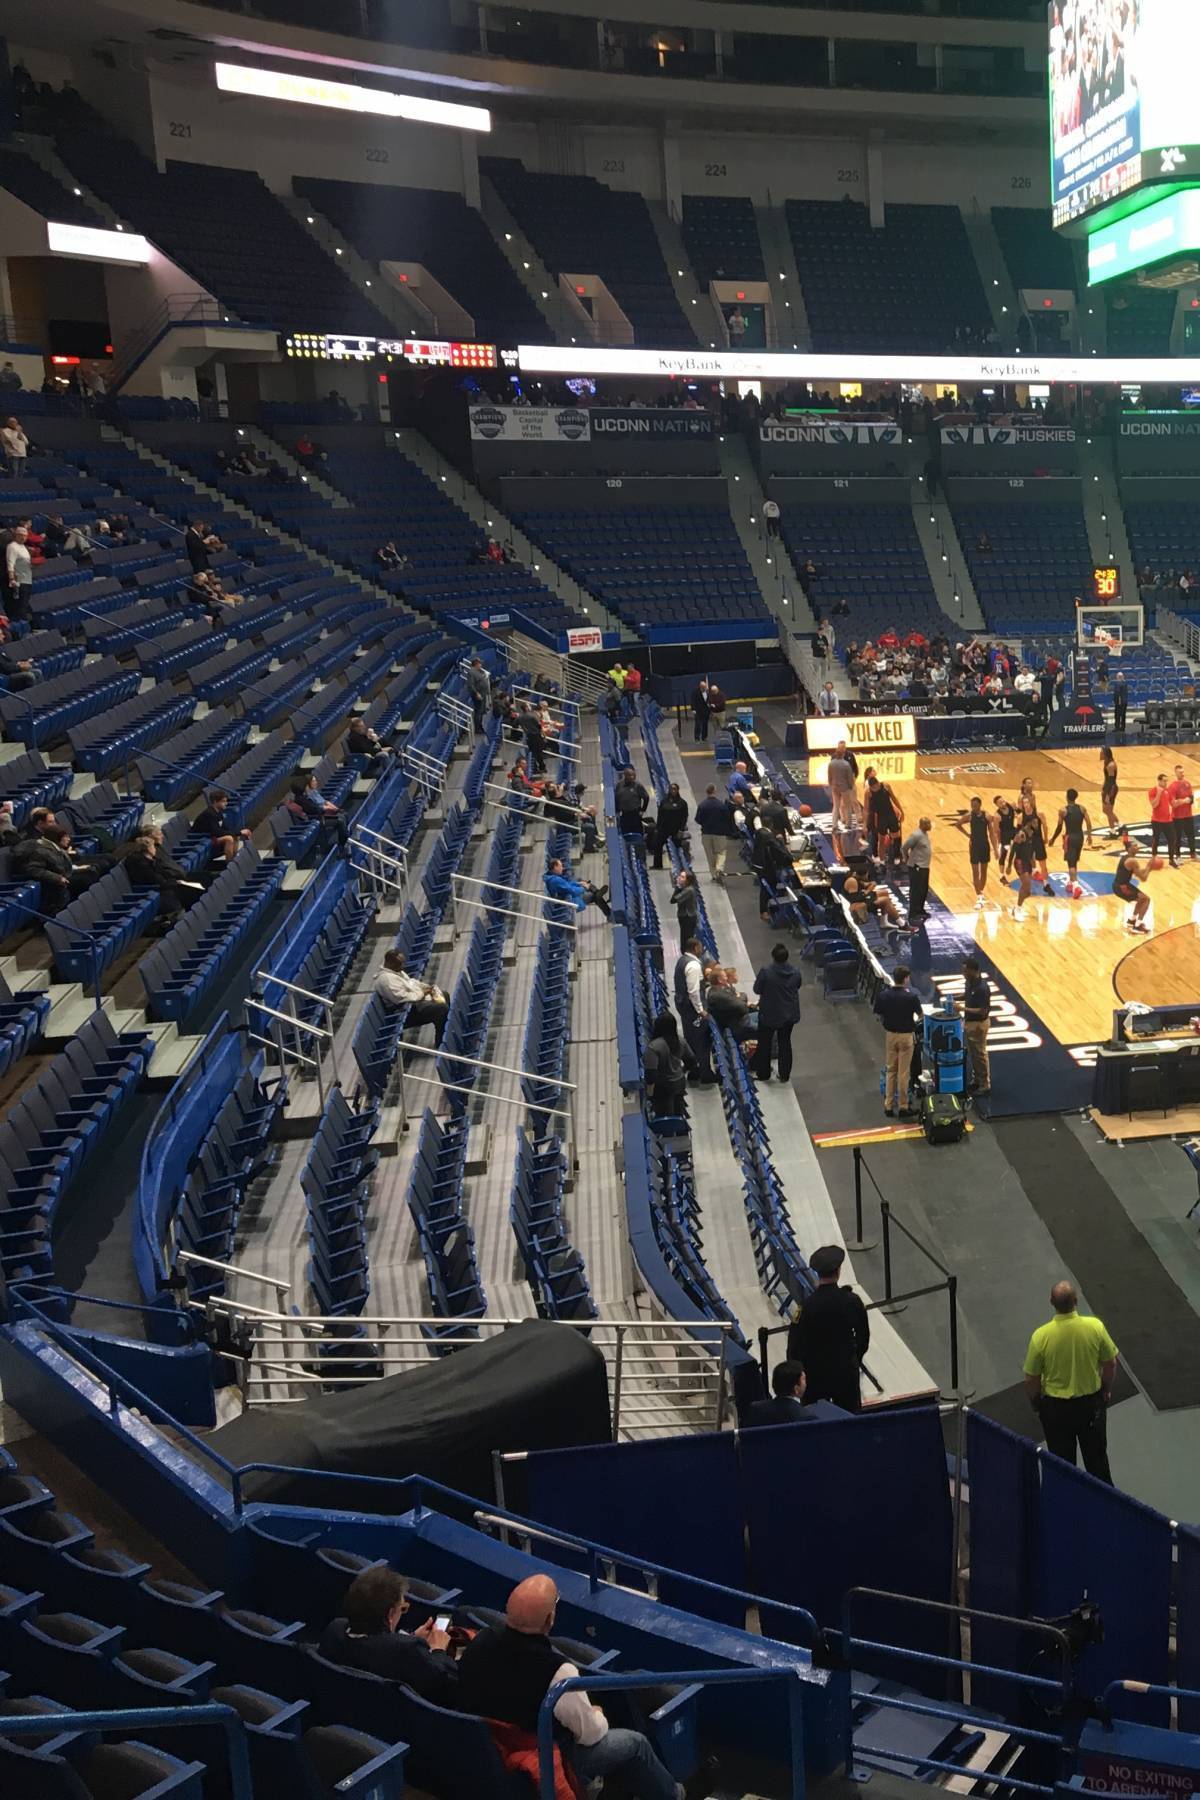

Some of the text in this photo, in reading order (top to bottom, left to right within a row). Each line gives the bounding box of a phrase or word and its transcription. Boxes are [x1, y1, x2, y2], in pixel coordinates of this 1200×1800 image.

[169, 122, 192, 138] 221
[366, 149, 389, 163] 222
[602, 160, 625, 173] 223
[704, 164, 727, 177] 224
[838, 169, 859, 182] 225
[1010, 176, 1031, 189] 226
[658, 358, 722, 372] KeyBank
[980, 363, 1041, 377] KeyBank
[594, 418, 650, 432] UCONN
[1120, 423, 1171, 436] UCONN
[760, 427, 824, 442] UCONN
[1016, 429, 1076, 442] HUSKIES
[606, 479, 622, 488] 120
[833, 480, 849, 488] 121
[1008, 480, 1024, 488] 122
[1098, 579, 1115, 594] 30
[570, 632, 601, 647] ESPN
[846, 721, 903, 742] YOLKED
[1063, 725, 1106, 733] TRAVELERS
[1087, 1777, 1107, 1792] TO
[1109, 1765, 1193, 1790] NO EXITING
